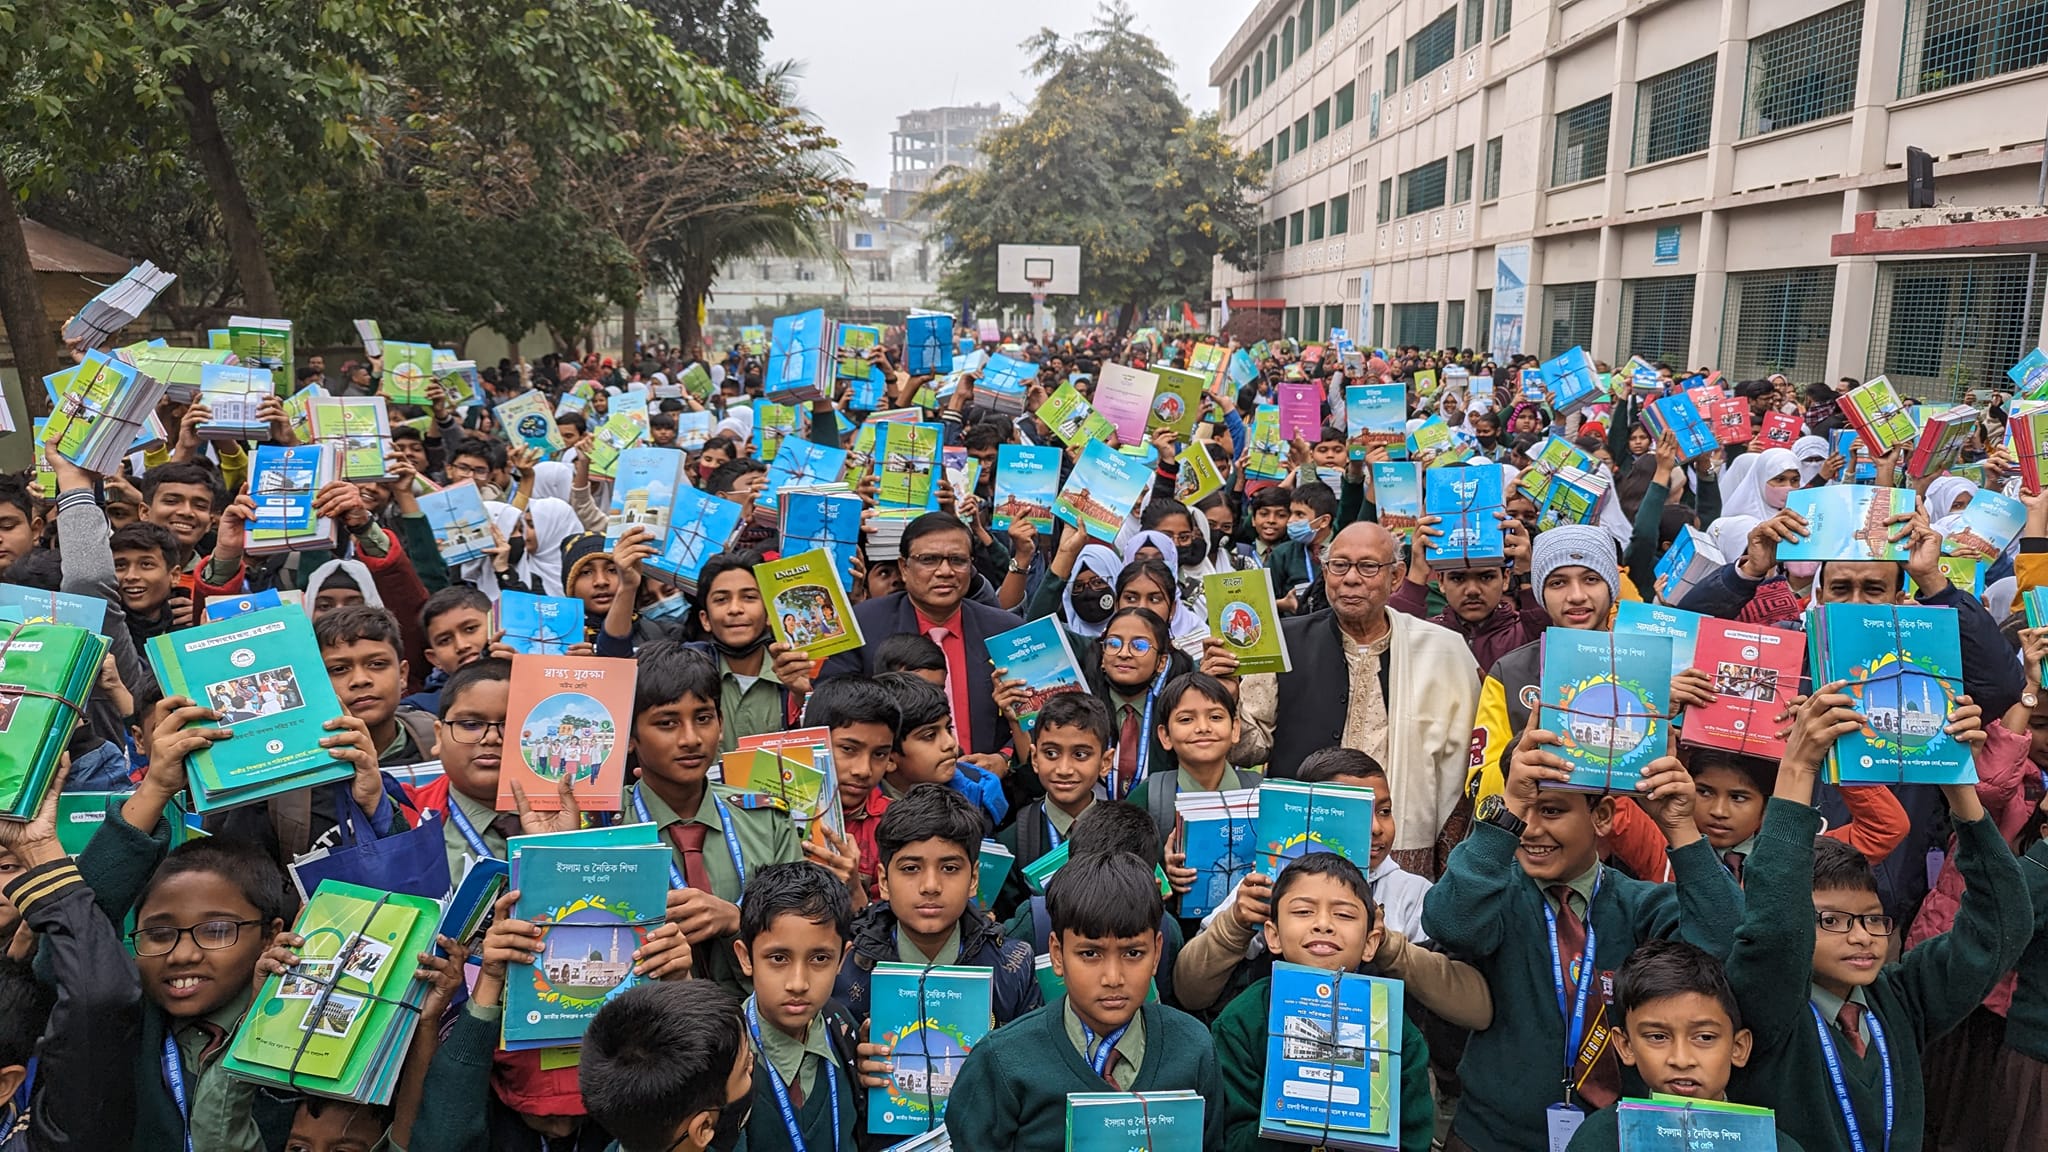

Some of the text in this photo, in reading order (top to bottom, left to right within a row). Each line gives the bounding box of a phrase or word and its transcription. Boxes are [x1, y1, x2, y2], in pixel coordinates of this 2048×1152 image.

[774, 564, 810, 580] ENGLISH
[1223, 576, 1242, 586] বাংলা
[1862, 618, 1884, 628] ইসলাম
[1886, 620, 1892, 628] ও
[1916, 619, 1933, 630] শিক্ষা
[1577, 643, 1598, 654] ইসলাম
[1630, 647, 1646, 658] শিক্ষা
[544, 668, 606, 680] স্বাস্থ্য সুরক্ষা
[1284, 803, 1302, 813] ইসলাম
[1310, 806, 1330, 816] নৈতিক
[1330, 806, 1345, 817] শিক্ষা
[556, 862, 581, 874] ইসলাম
[592, 862, 618, 874] নৈতিক
[619, 862, 638, 873] শিক্ষা
[582, 874, 596, 884] চতুর্থ
[1583, 960, 1593, 974] MODEL
[1579, 974, 1590, 990] SCHOOL
[898, 988, 962, 1000] ইসলাম নৈতিক শিক্ষা
[1578, 990, 1587, 999] AND
[1574, 998, 1586, 1018] COLLEGE
[1579, 1024, 1608, 1066] REBGMSC
[1305, 1069, 1320, 1078] চতুর্থ
[1830, 1064, 1842, 1087] BOARD
[777, 1092, 790, 1108] BOARD
[1841, 1098, 1853, 1116] MODEL
[786, 1121, 799, 1134] MODEL
[1104, 1117, 1126, 1128] ইসলাম
[1158, 1114, 1175, 1125] শিক্ষা
[1844, 1112, 1858, 1134] SCHOOL
[1656, 1125, 1742, 1141] ইসলাম নৈতিক শিক্ষা
[1850, 1130, 1860, 1142] AND
[792, 1134, 806, 1150] SCHOOL
[1700, 1142, 1714, 1150] শ্রেণি
